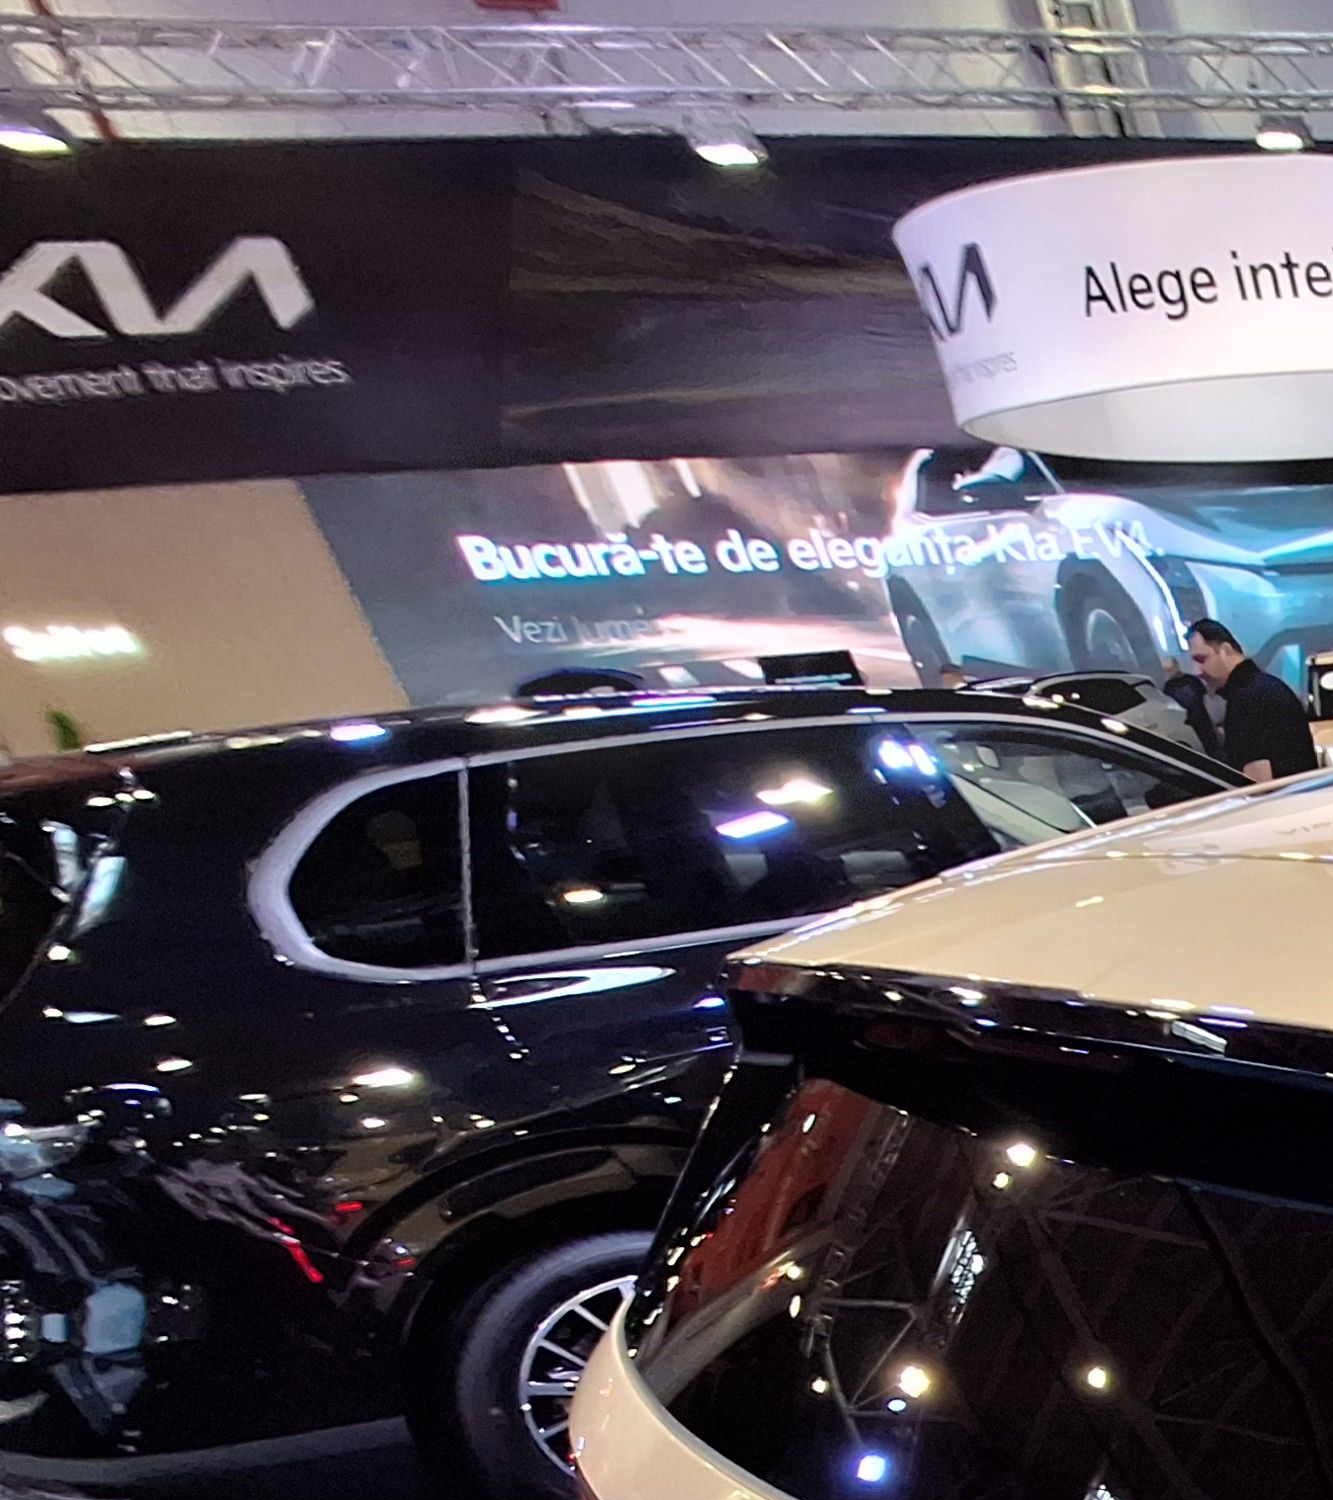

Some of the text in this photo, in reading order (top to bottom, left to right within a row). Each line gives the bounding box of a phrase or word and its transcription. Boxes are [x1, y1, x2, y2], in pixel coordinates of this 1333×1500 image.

[1084, 262, 1219, 321] Alege
[0, 363, 145, 402] ovement
[457, 531, 708, 580] Bucură-te
[716, 528, 779, 573] de
[493, 614, 568, 644] Vezi
